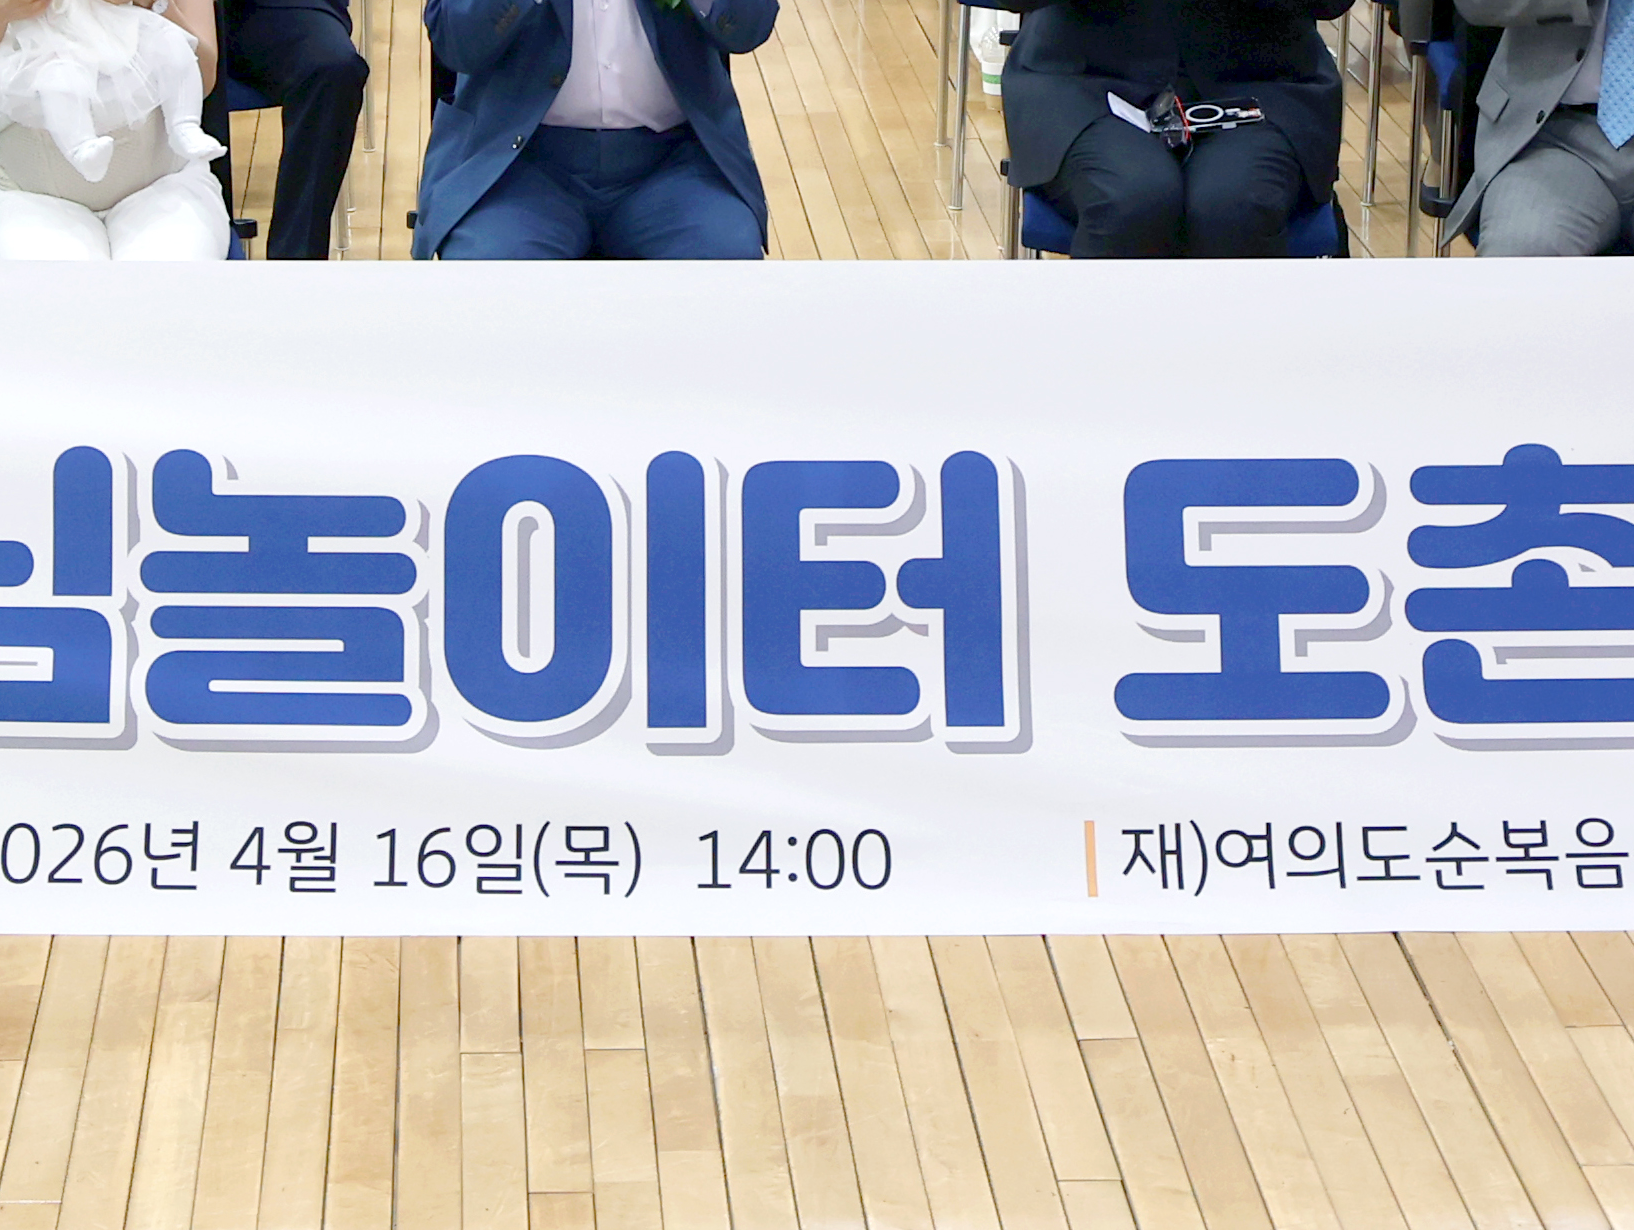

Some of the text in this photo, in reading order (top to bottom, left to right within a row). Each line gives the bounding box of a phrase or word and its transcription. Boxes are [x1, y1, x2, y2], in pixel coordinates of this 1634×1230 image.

[230, 820, 337, 892] 4월
[372, 820, 641, 897] 16일(목)
[696, 828, 892, 889] 14:00
